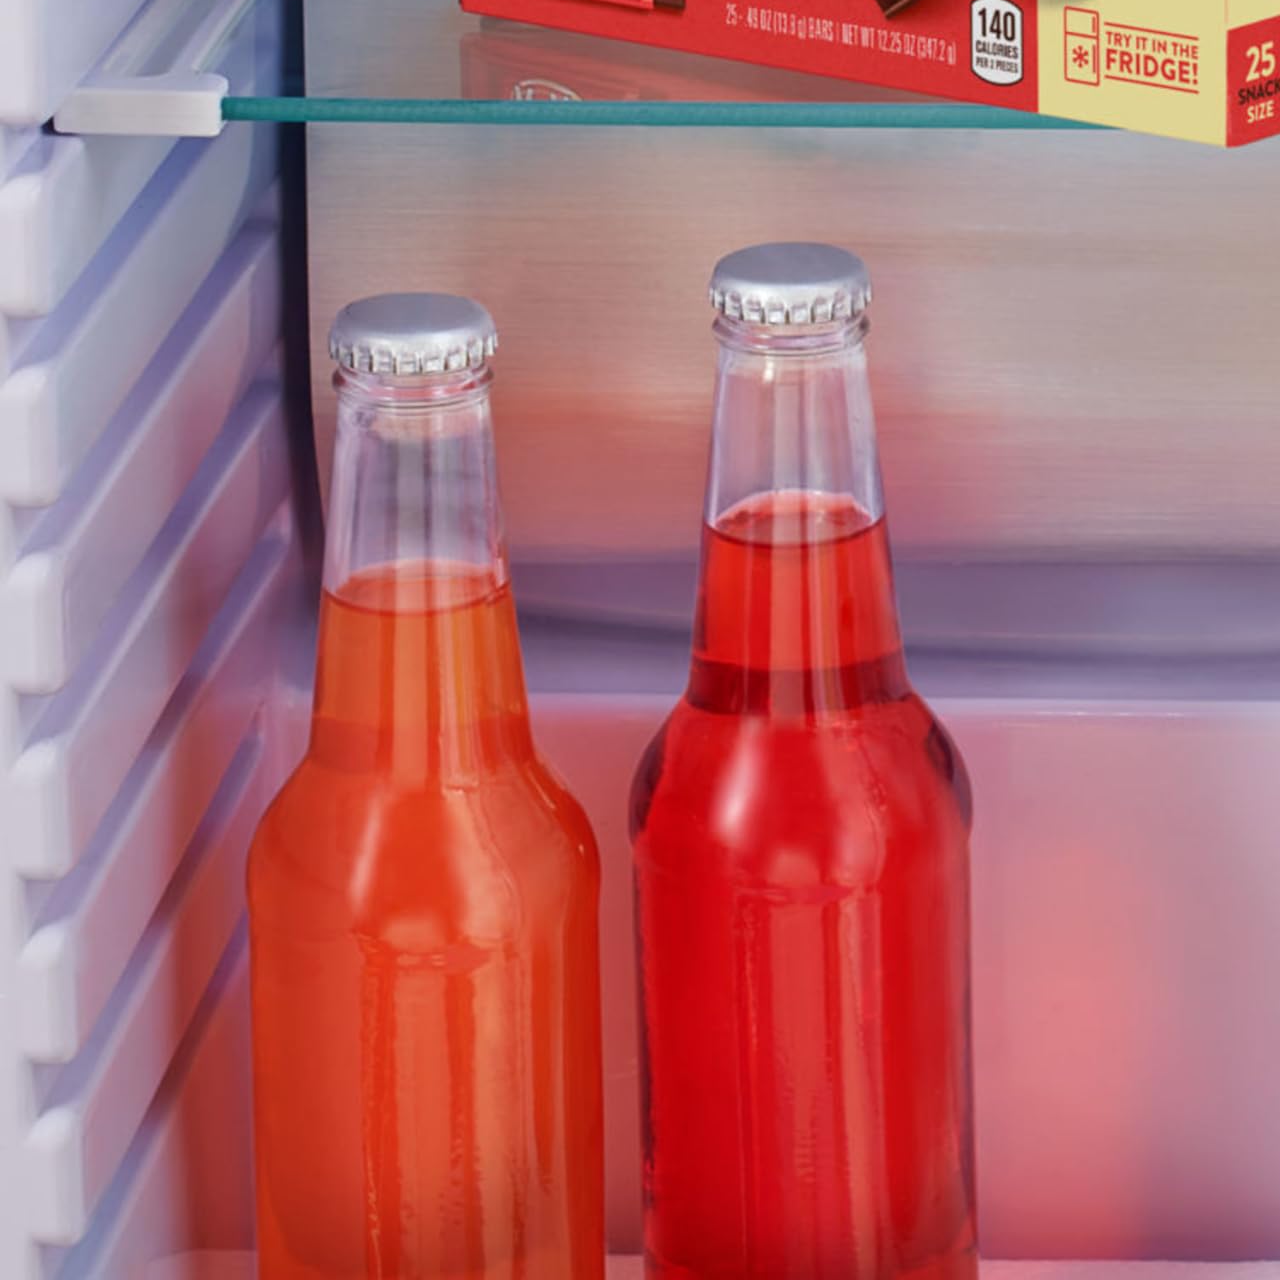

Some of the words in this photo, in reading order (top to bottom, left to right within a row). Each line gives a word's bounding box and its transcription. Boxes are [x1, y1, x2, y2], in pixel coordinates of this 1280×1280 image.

[808, 16, 834, 42] BARS
[977, 7, 1017, 42] 140
[975, 39, 1019, 59] CALORIES
[1105, 31, 1132, 48] TRY
[1135, 36, 1149, 51] IT
[1152, 39, 1167, 54] IN
[1172, 42, 1199, 60] THE
[1105, 48, 1199, 85] FRIDGE!
[1246, 40, 1276, 82] 25
[1247, 99, 1275, 123] SIZE
